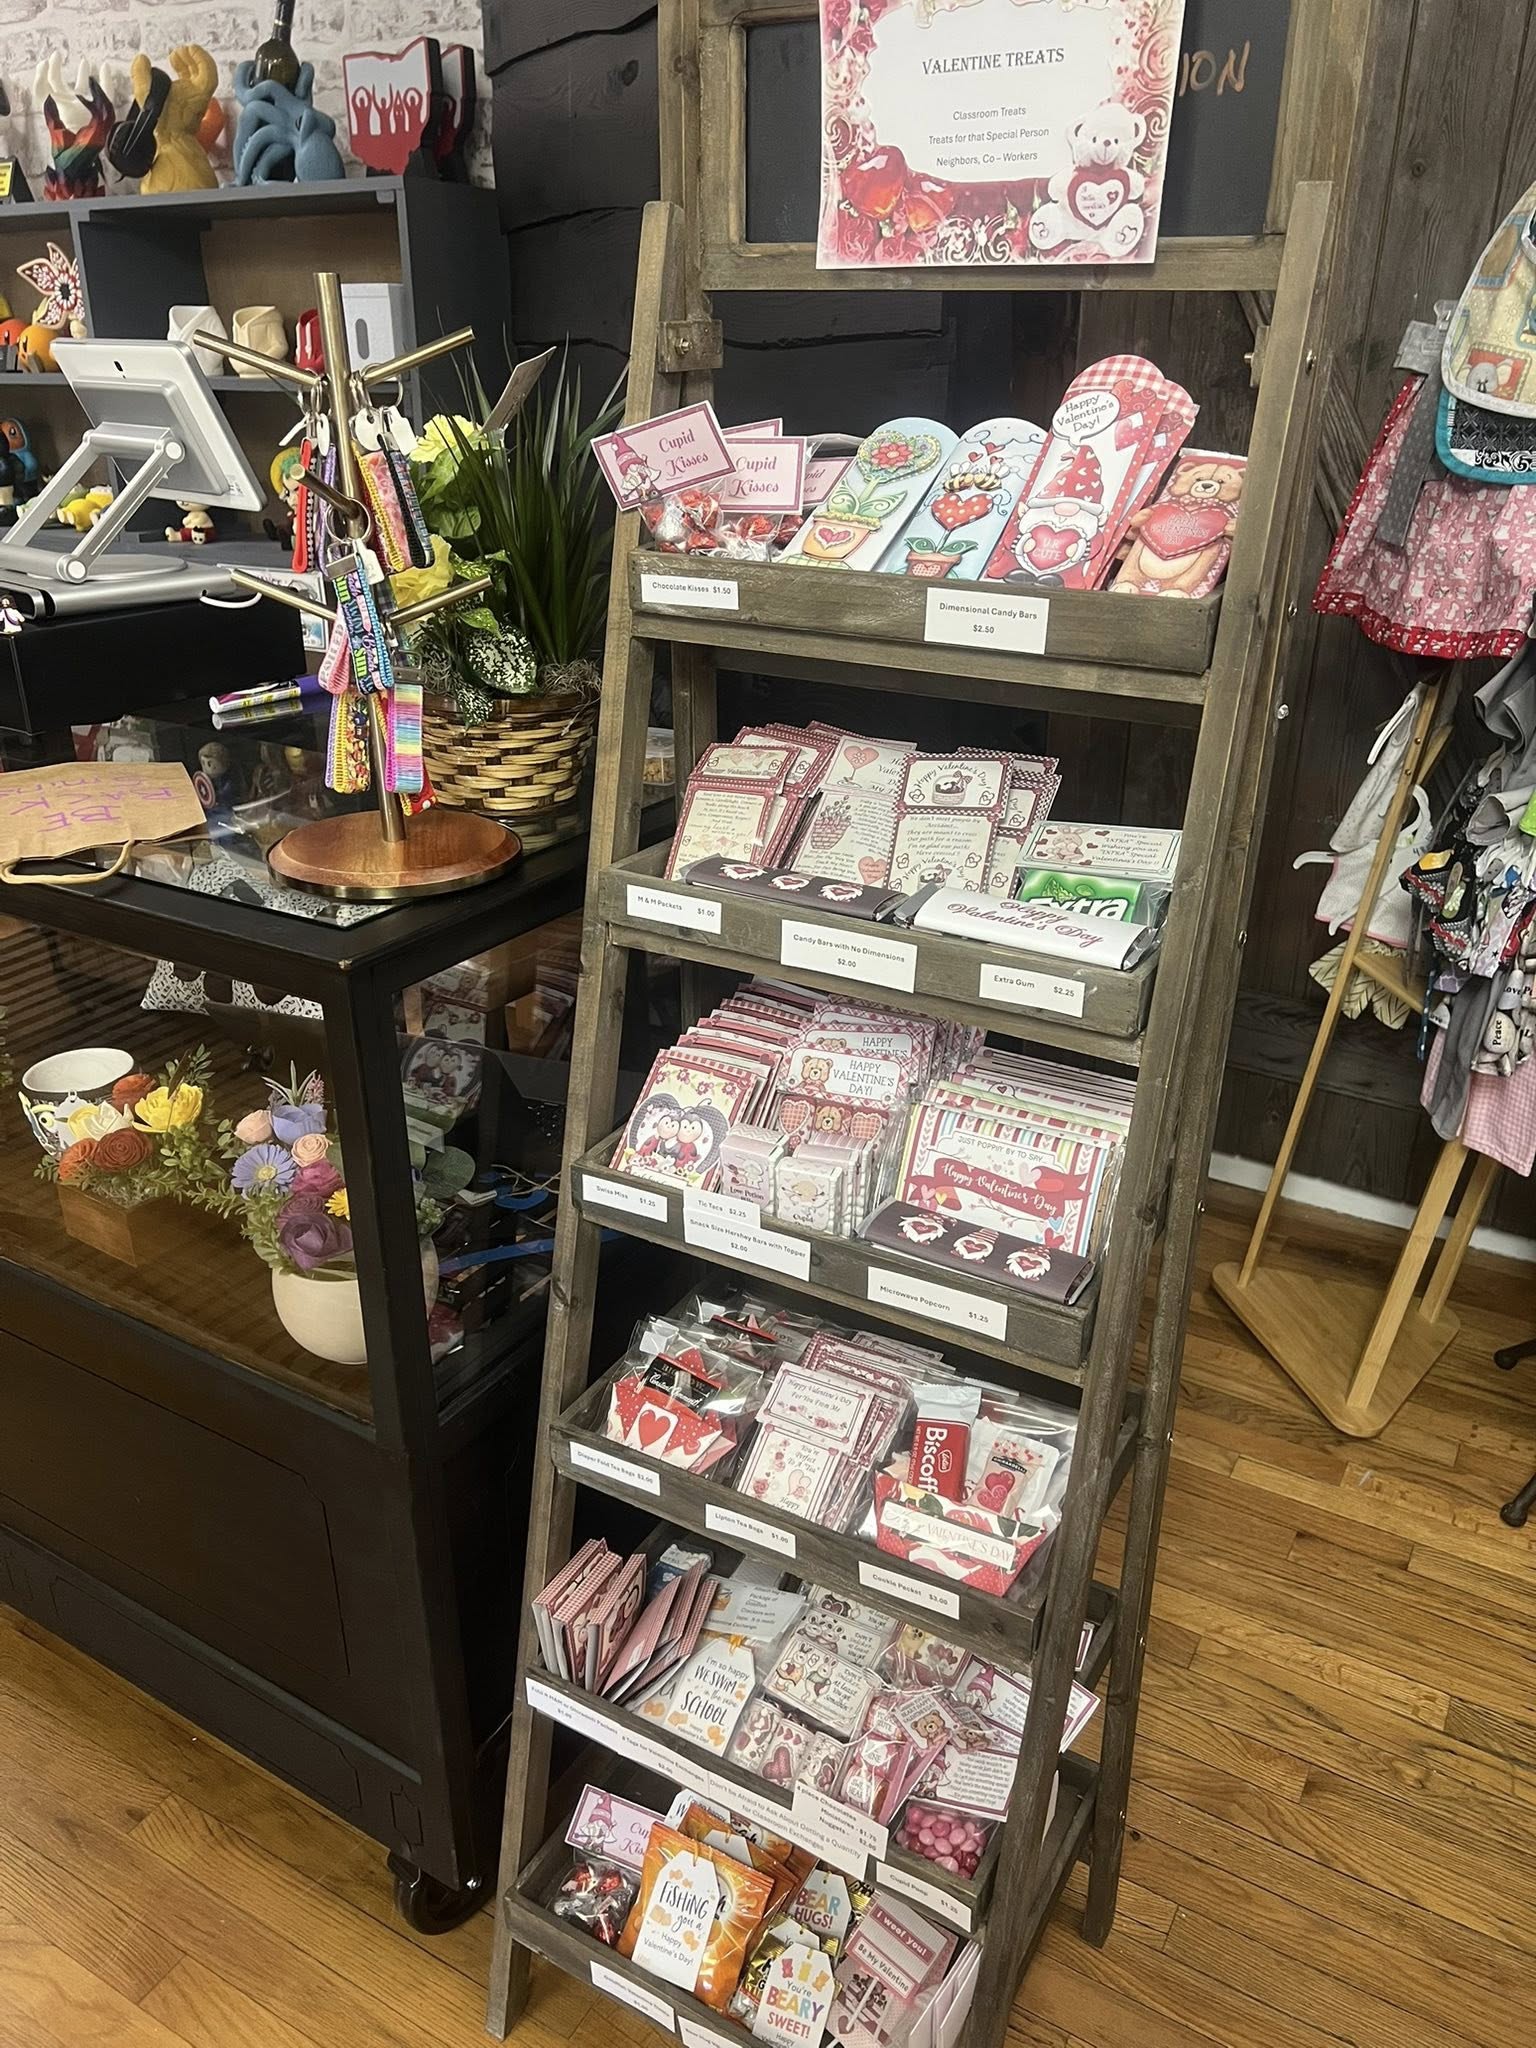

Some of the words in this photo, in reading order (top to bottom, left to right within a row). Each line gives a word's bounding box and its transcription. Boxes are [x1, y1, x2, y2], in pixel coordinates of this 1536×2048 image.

[922, 54, 1001, 74] VALENTINE
[1006, 48, 1064, 67] TREATS
[953, 109, 998, 120] Classroom
[1001, 107, 1026, 117] Treats
[929, 136, 953, 144] Treats
[955, 134, 966, 143] for
[968, 133, 984, 142] that
[986, 129, 1018, 144] Special
[1020, 128, 1049, 138] Person
[936, 156, 980, 168] Neighbors,
[982, 154, 995, 163] Co
[1003, 152, 1038, 161] Workers
[1057, 400, 1114, 426] Valentine's
[1065, 395, 1099, 413] Happy
[1073, 416, 1099, 432] Day!
[659, 428, 695, 452] Cupid
[665, 452, 708, 480] Kisses
[736, 456, 777, 472] Cupid
[728, 478, 779, 499] Kisses
[1032, 550, 1061, 561] CUTE
[652, 582, 686, 590] Chocolate
[713, 586, 731, 594] $1.50
[940, 602, 989, 615] Dimensional
[992, 608, 1017, 618] Candy
[1019, 611, 1037, 619] Bars
[973, 625, 994, 633] $2.50
[913, 767, 937, 789] Happy
[938, 762, 978, 774] Valentine's
[697, 908, 715, 917] $1.00
[1000, 902, 1071, 924] Happy
[947, 903, 1047, 931] Valentine's
[1055, 925, 1104, 948] Day
[793, 934, 816, 945] Candy
[818, 939, 833, 948] Bars
[834, 943, 849, 951] with
[862, 948, 905, 962] Dimensions
[838, 958, 856, 968] $2.00
[994, 975, 1014, 985] Extra
[1016, 979, 1035, 988] Gum
[1053, 986, 1075, 997] $2.25
[863, 1037, 893, 1047] HAPPY
[1492, 1020, 1502, 1046] Peace
[850, 1060, 881, 1073] HAPPY
[833, 1069, 895, 1087] VALENTINE'S
[849, 1084, 873, 1096] DAY!
[597, 1186, 613, 1195] Swiss
[615, 1191, 628, 1199] Miss
[640, 1198, 656, 1207] $1.25
[730, 1186, 744, 1194] Love
[745, 1188, 764, 1200] Potion
[942, 1163, 973, 1186] Happy
[1031, 1193, 1057, 1215] Day
[709, 1202, 723, 1212] Tacs
[729, 1208, 746, 1218] $2.25
[690, 1219, 709, 1228] Snack
[711, 1225, 724, 1233] Size
[725, 1227, 752, 1242] Hershey
[753, 1235, 767, 1245] Bars
[769, 1240, 782, 1250] with
[784, 1245, 806, 1258] Topper
[731, 1242, 748, 1252] $2.00
[880, 1285, 919, 1302] Microwave
[920, 1296, 951, 1311] Popcorn
[968, 1311, 989, 1323] $1.25
[787, 1379, 808, 1391] Happy
[808, 1384, 838, 1401] Valentine's
[839, 1395, 852, 1406] Day
[918, 1427, 948, 1493] Biscoff
[621, 1468, 635, 1477] Bags
[781, 1497, 800, 1510] Happy
[715, 1513, 736, 1524] Lipton
[736, 1520, 747, 1528] Tea
[748, 1524, 763, 1534] Bags
[772, 1533, 788, 1543] $1.00
[873, 1574, 896, 1587] Cookie
[695, 1665, 710, 1682] WE
[706, 1656, 717, 1667] I'm
[719, 1662, 727, 1670] so
[728, 1666, 750, 1681] happy
[681, 1691, 727, 1726] SCHOOL
[710, 1779, 727, 1793] Don't
[738, 1791, 757, 1807] Afraid
[757, 1802, 765, 1810] to
[766, 1806, 778, 1817] Ask
[779, 1812, 799, 1827] About
[800, 1823, 825, 1843] Getting
[831, 1838, 861, 1859] Quantity
[820, 1798, 857, 1821] Chocolates
[821, 1807, 856, 1830] Miniatures
[742, 1804, 751, 1813] for
[752, 1810, 788, 1833] Classroom
[789, 1827, 824, 1851] Exchanges
[819, 1816, 846, 1834] Nuggets
[623, 1838, 644, 1855] Kis
[796, 1888, 841, 1916] BEAR
[890, 1874, 910, 1888] Cupid
[941, 1899, 958, 1914] $1.25
[671, 1914, 694, 1933] you
[696, 1922, 702, 1930] a
[794, 1907, 833, 1929] HUGS!
[661, 1930, 682, 1947] Happy
[884, 1917, 906, 1938] woof
[906, 1937, 926, 1956] you!
[643, 1937, 677, 1959] Valentine's
[678, 1951, 694, 1966] Day!
[858, 1944, 868, 1954] Be
[867, 1952, 878, 1965] My
[880, 1962, 909, 1991] Valentine
[787, 1981, 812, 1997] You're
[766, 1986, 825, 2022] BEARY
[767, 2012, 811, 2039] SWEET!
[776, 2033, 794, 2046] Happy
